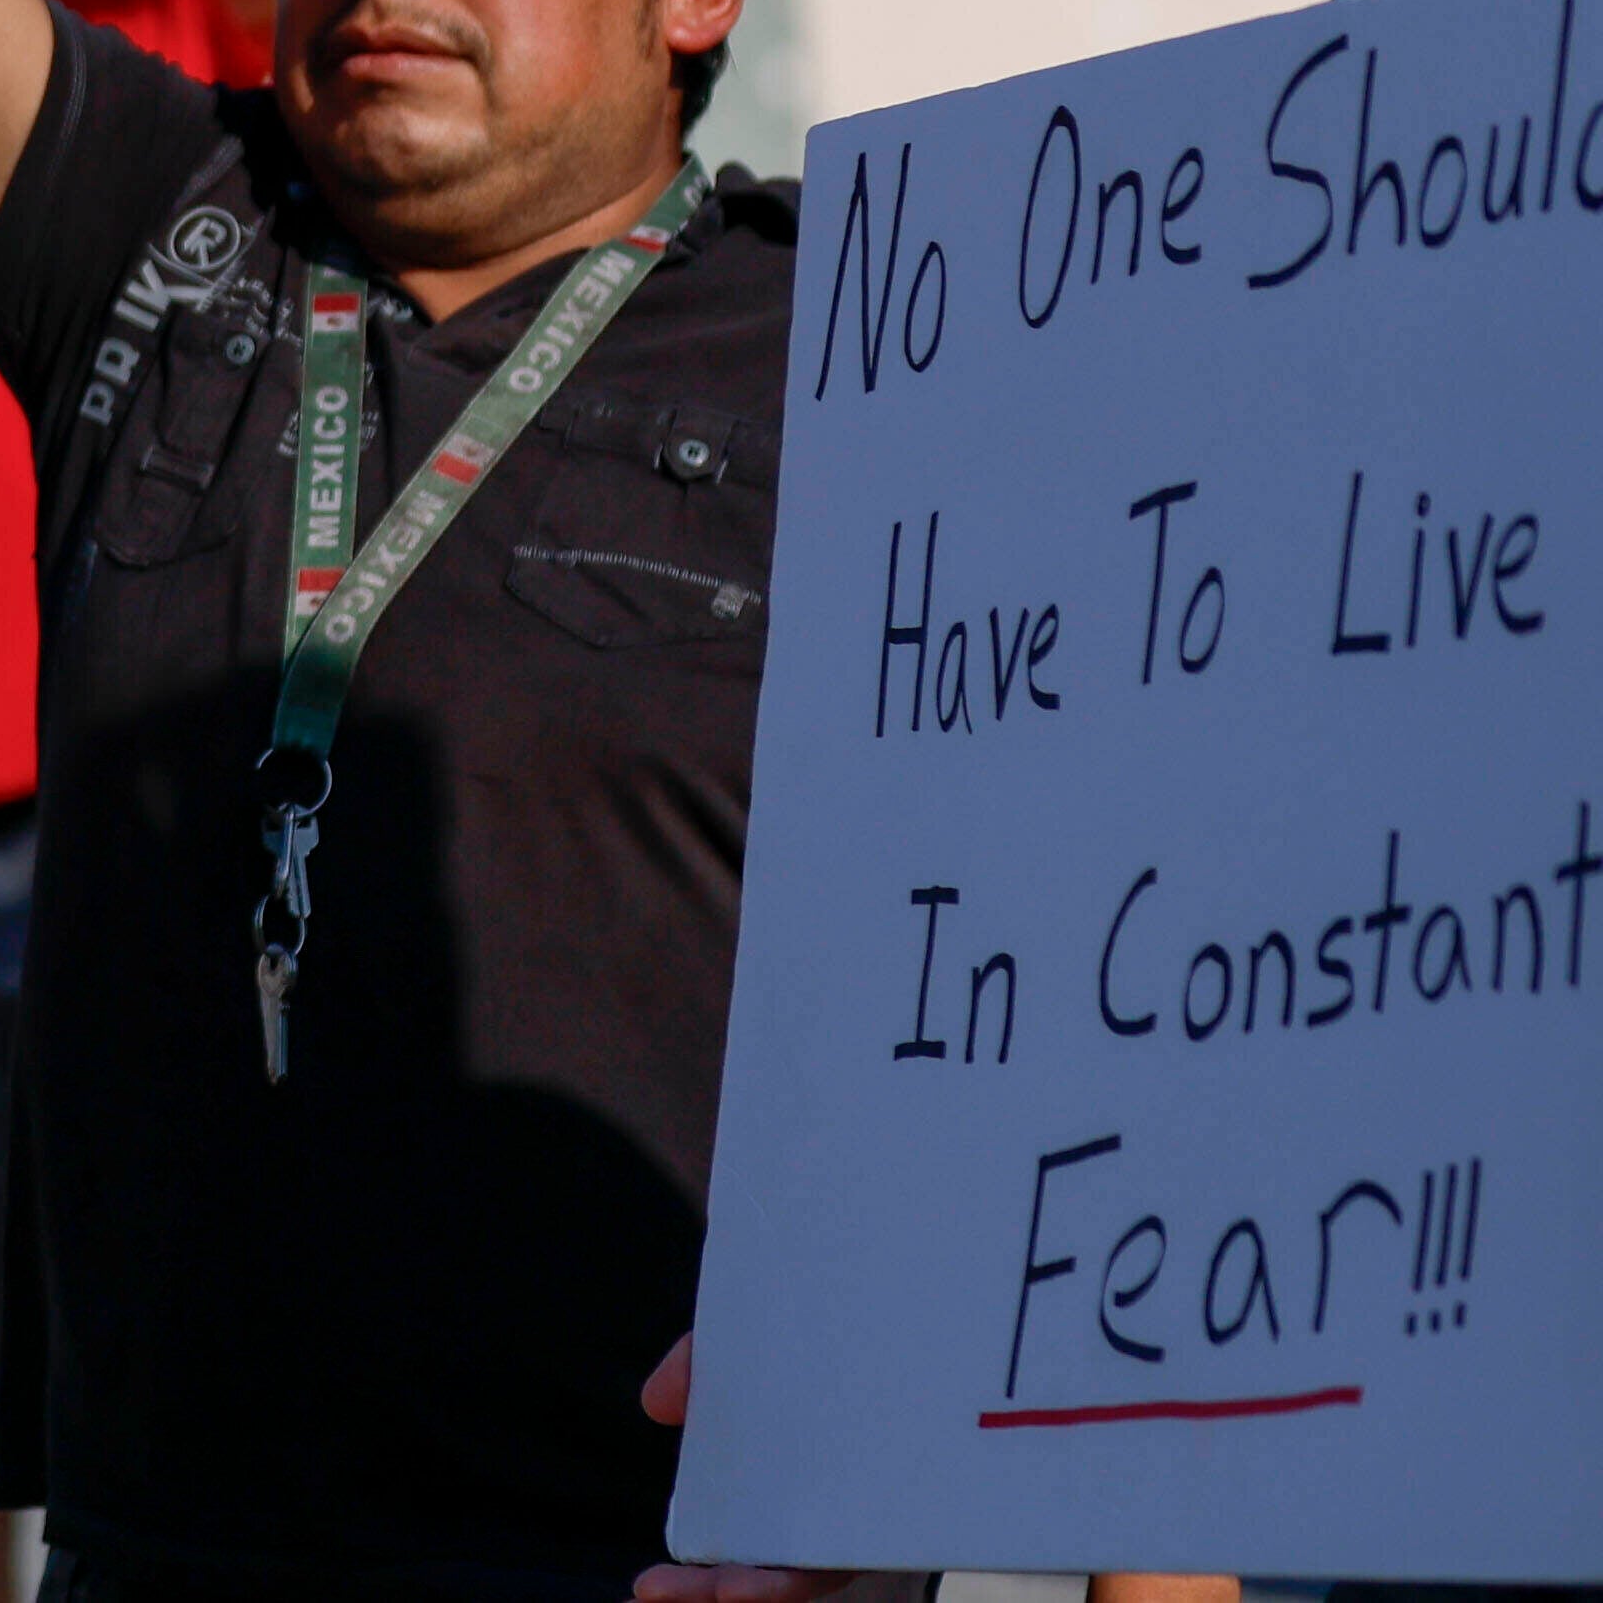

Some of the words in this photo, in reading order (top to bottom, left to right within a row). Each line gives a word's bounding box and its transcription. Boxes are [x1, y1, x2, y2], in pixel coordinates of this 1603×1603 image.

[509, 249, 636, 393] MEXICO
[814, 142, 947, 402] No
[1018, 104, 1205, 330] One
[307, 385, 349, 547] MEXICO
[325, 489, 449, 643] MEXICO
[875, 509, 1061, 739] Have
[1128, 480, 1229, 686] To
[1329, 471, 1546, 658] Live
[892, 884, 1017, 1065] In
[1098, 800, 1603, 1043] Constant
[1004, 1133, 1483, 1399] Fear!!!
